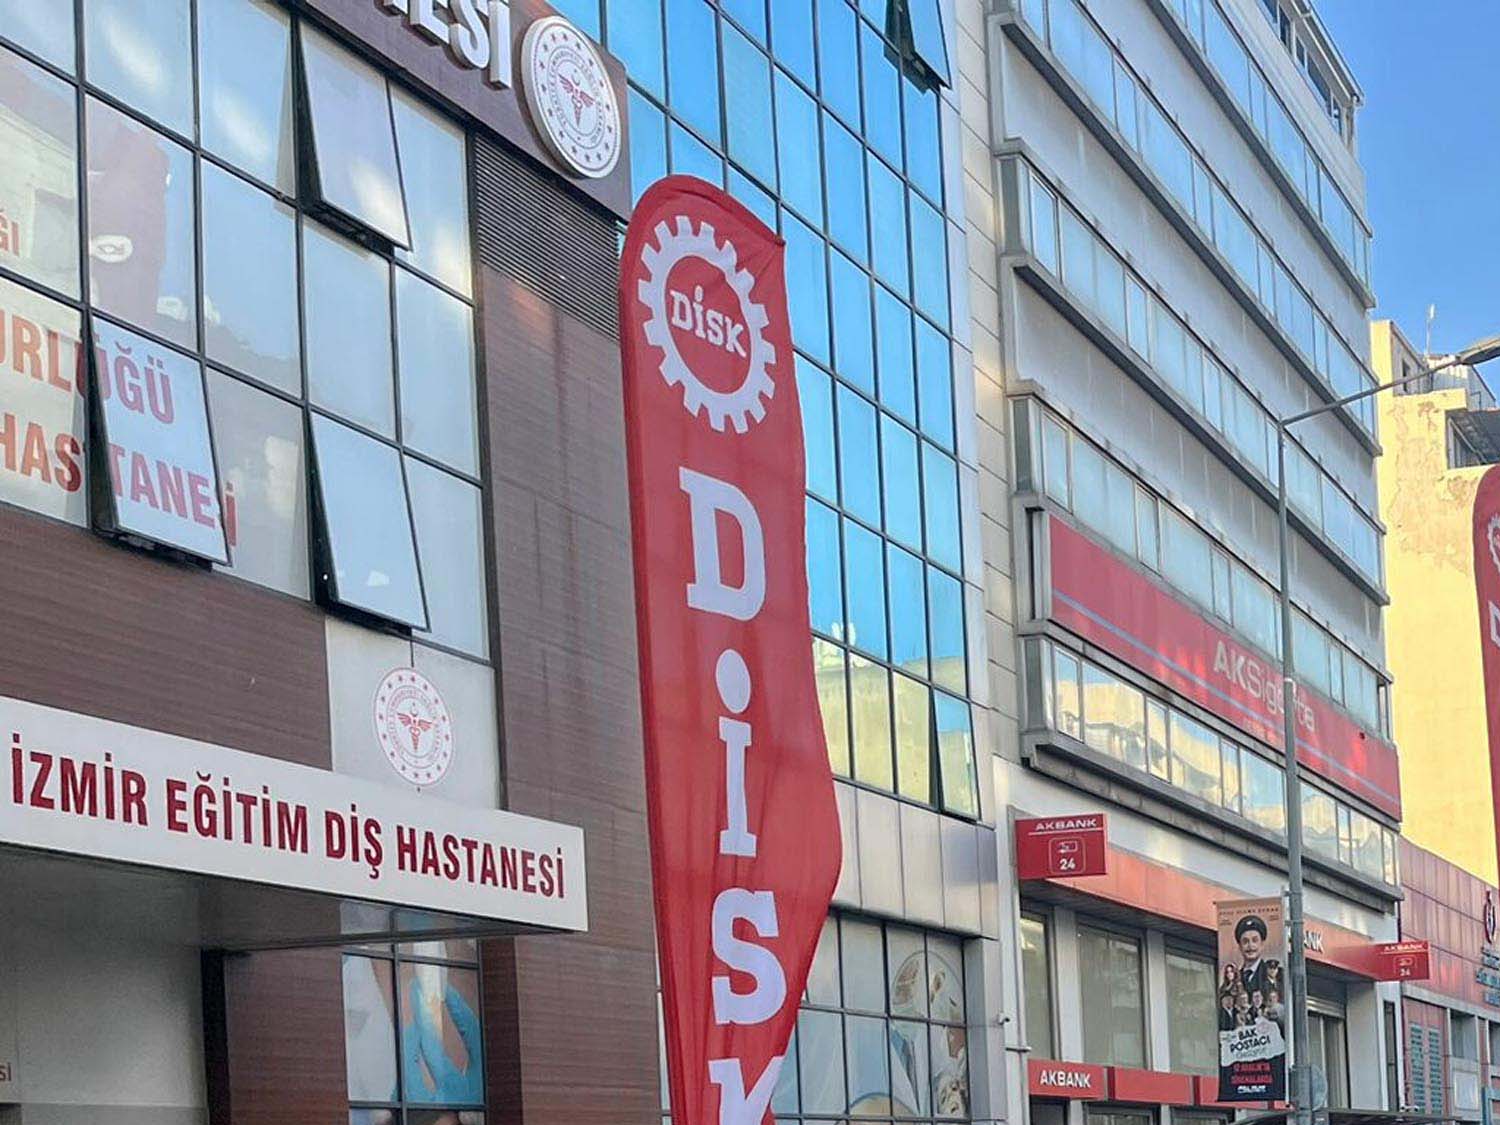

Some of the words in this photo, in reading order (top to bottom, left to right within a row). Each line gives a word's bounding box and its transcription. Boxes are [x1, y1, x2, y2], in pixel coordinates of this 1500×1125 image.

[669, 285, 745, 358] DİSK
[9, 733, 148, 827] İZMİR
[165, 771, 309, 854] EĞİTİM
[324, 803, 384, 880] DİŞ
[396, 825, 566, 899] HASTANESİ
[1035, 818, 1098, 831] AKBANK
[1059, 857, 1076, 871] 24
[1039, 1069, 1091, 1088] AKBANK
